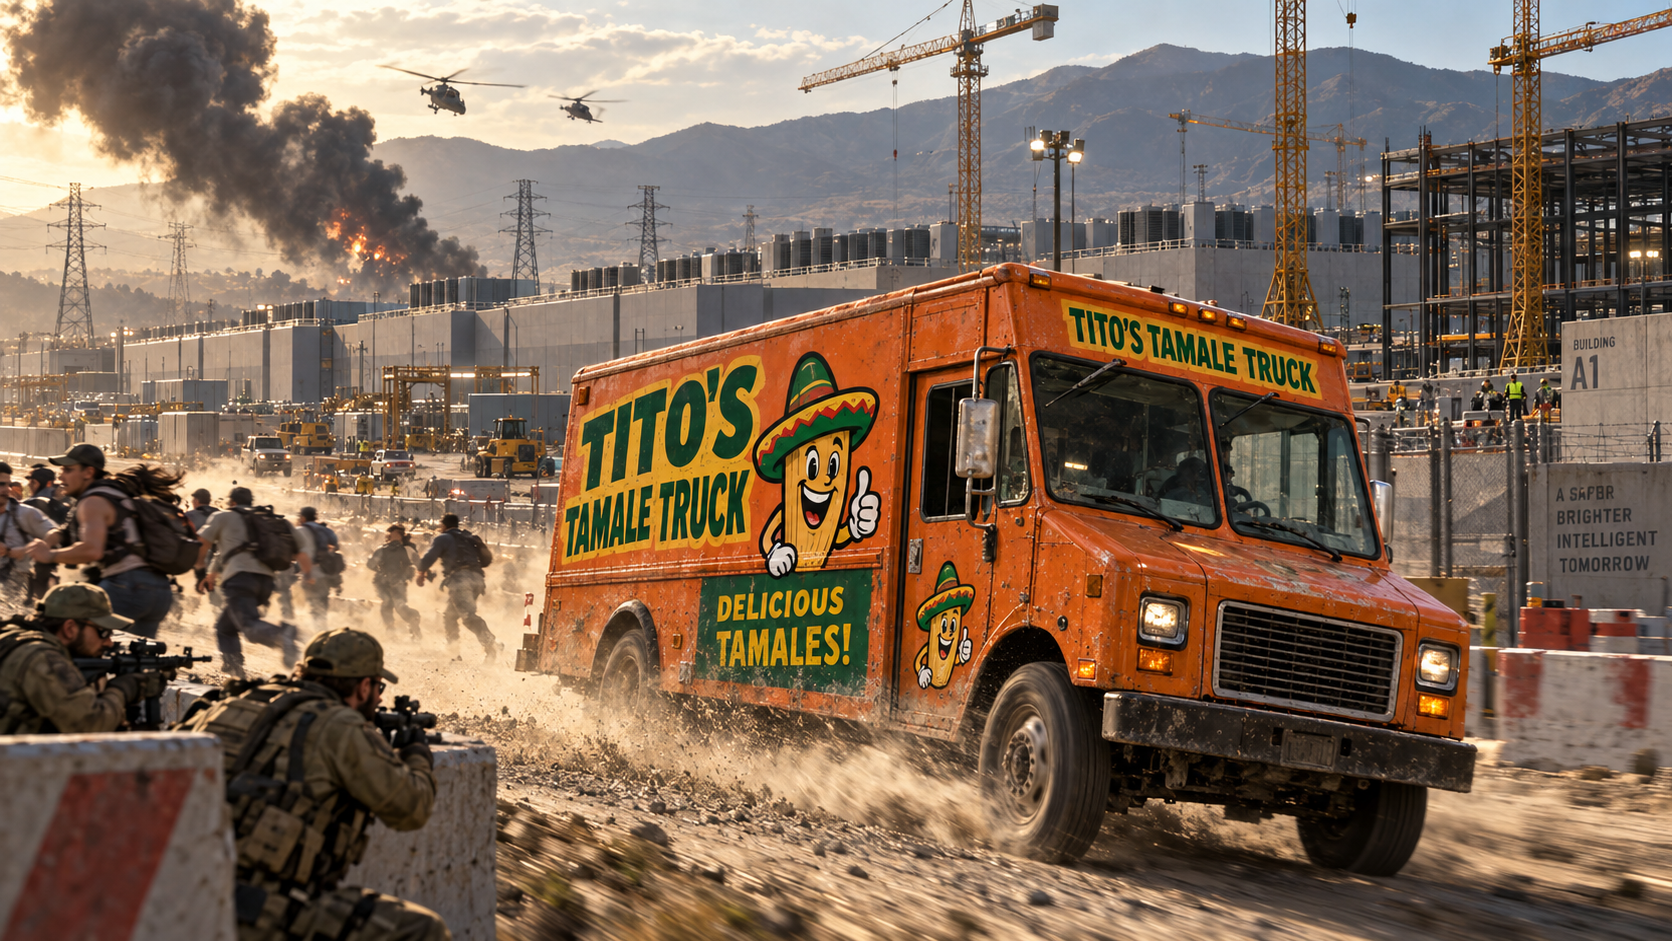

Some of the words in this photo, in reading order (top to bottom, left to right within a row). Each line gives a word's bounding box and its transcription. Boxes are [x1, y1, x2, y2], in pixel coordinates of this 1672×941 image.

[1069, 307, 1144, 354] TITO'S
[1147, 324, 1237, 375] TAMALE
[1242, 347, 1316, 393] TRUCK
[1573, 336, 1615, 350] BUILDING
[1570, 354, 1598, 390] A1
[582, 365, 758, 492] TITO'S
[1555, 487, 1565, 502] A
[565, 485, 653, 558] TAMALE
[659, 469, 750, 541] TRUCK
[1557, 508, 1632, 525] BRIGHTER
[1557, 531, 1658, 549] INTELLIGENT
[1559, 556, 1650, 573] TOMORROW
[716, 586, 844, 622] DELICIOUS
[716, 623, 851, 667] TAMALES!
